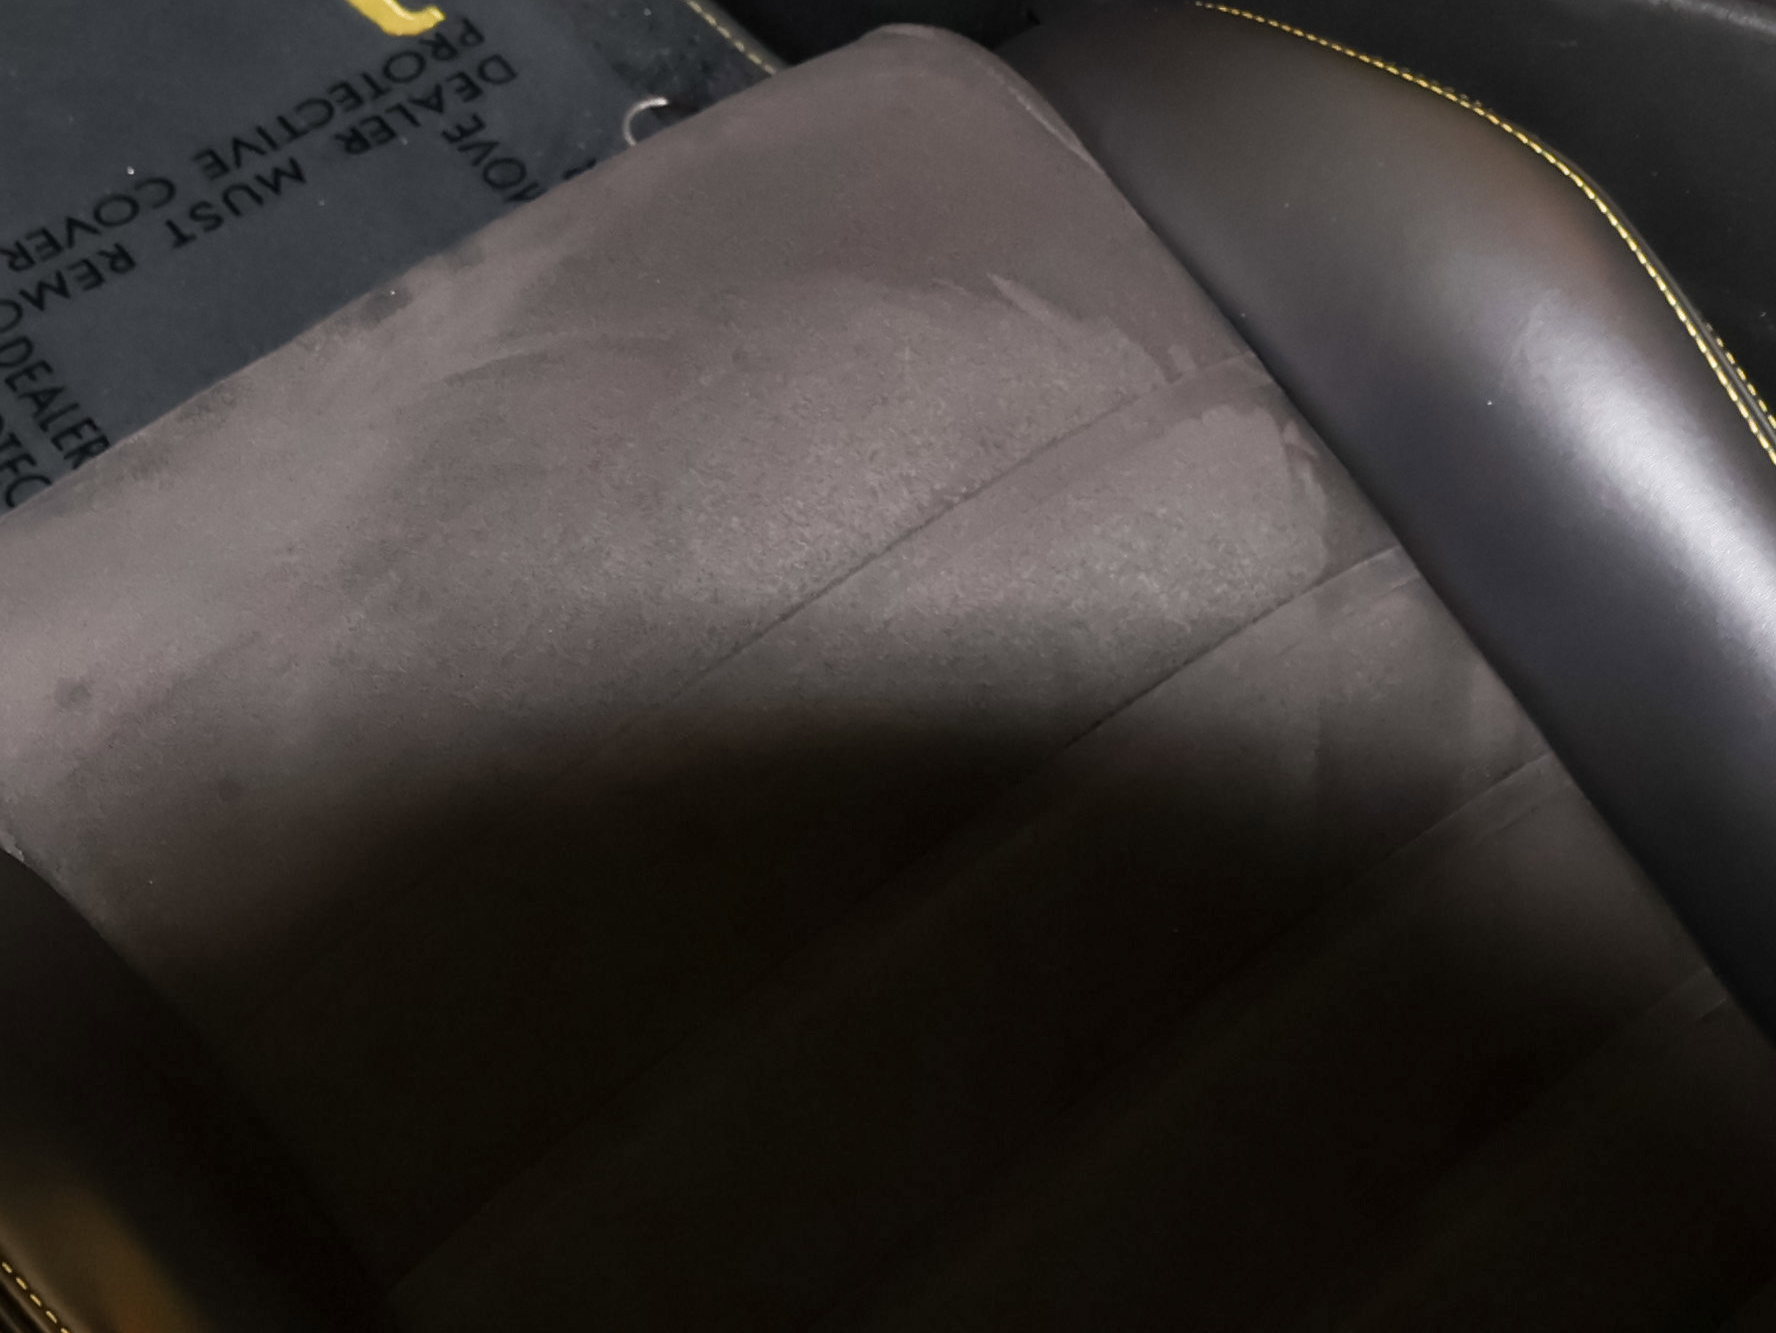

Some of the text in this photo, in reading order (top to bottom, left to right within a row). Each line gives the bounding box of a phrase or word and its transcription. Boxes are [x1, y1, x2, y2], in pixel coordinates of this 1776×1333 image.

[192, 13, 484, 184] PROTECTIVE
[333, 51, 516, 163] DEALER
[160, 154, 306, 250] MUST
